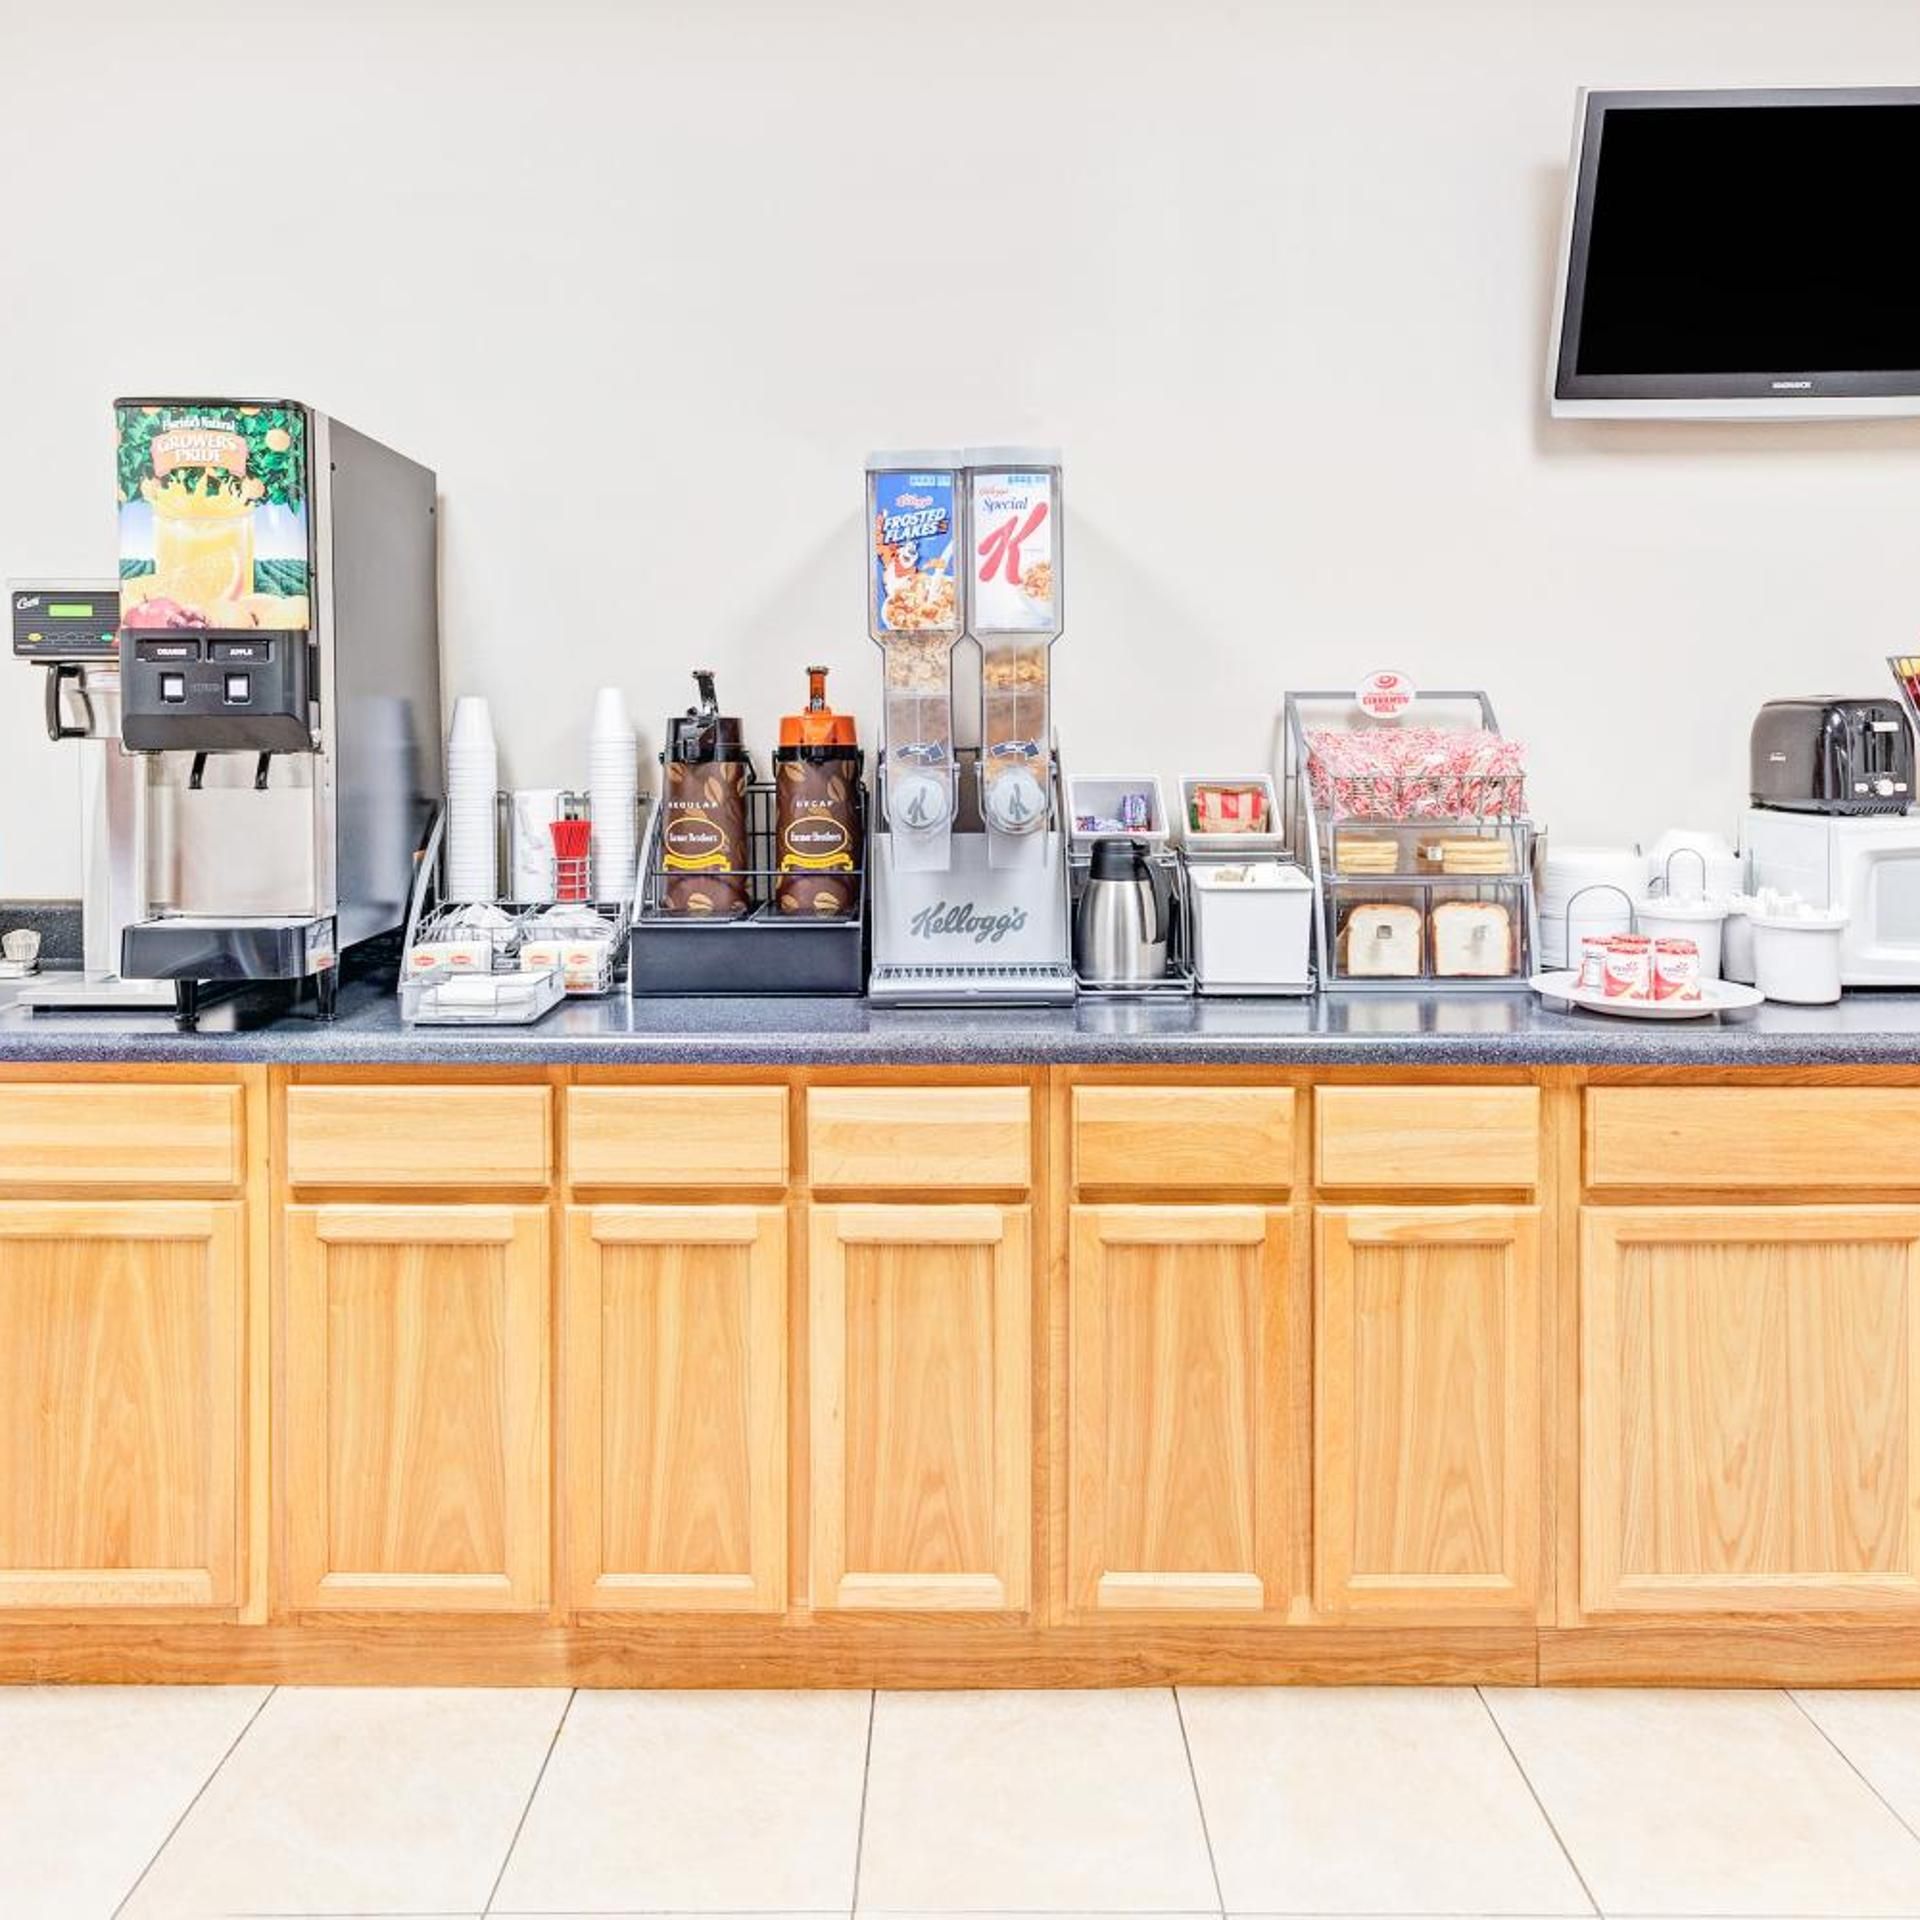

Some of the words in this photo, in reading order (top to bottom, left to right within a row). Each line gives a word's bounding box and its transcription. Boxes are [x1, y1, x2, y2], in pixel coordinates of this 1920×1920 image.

[982, 496, 1028, 513] Special
[884, 508, 946, 531] FROSTED
[884, 521, 938, 544] FLAKES
[977, 501, 1049, 586] K
[909, 900, 1029, 944] Kellogg's
